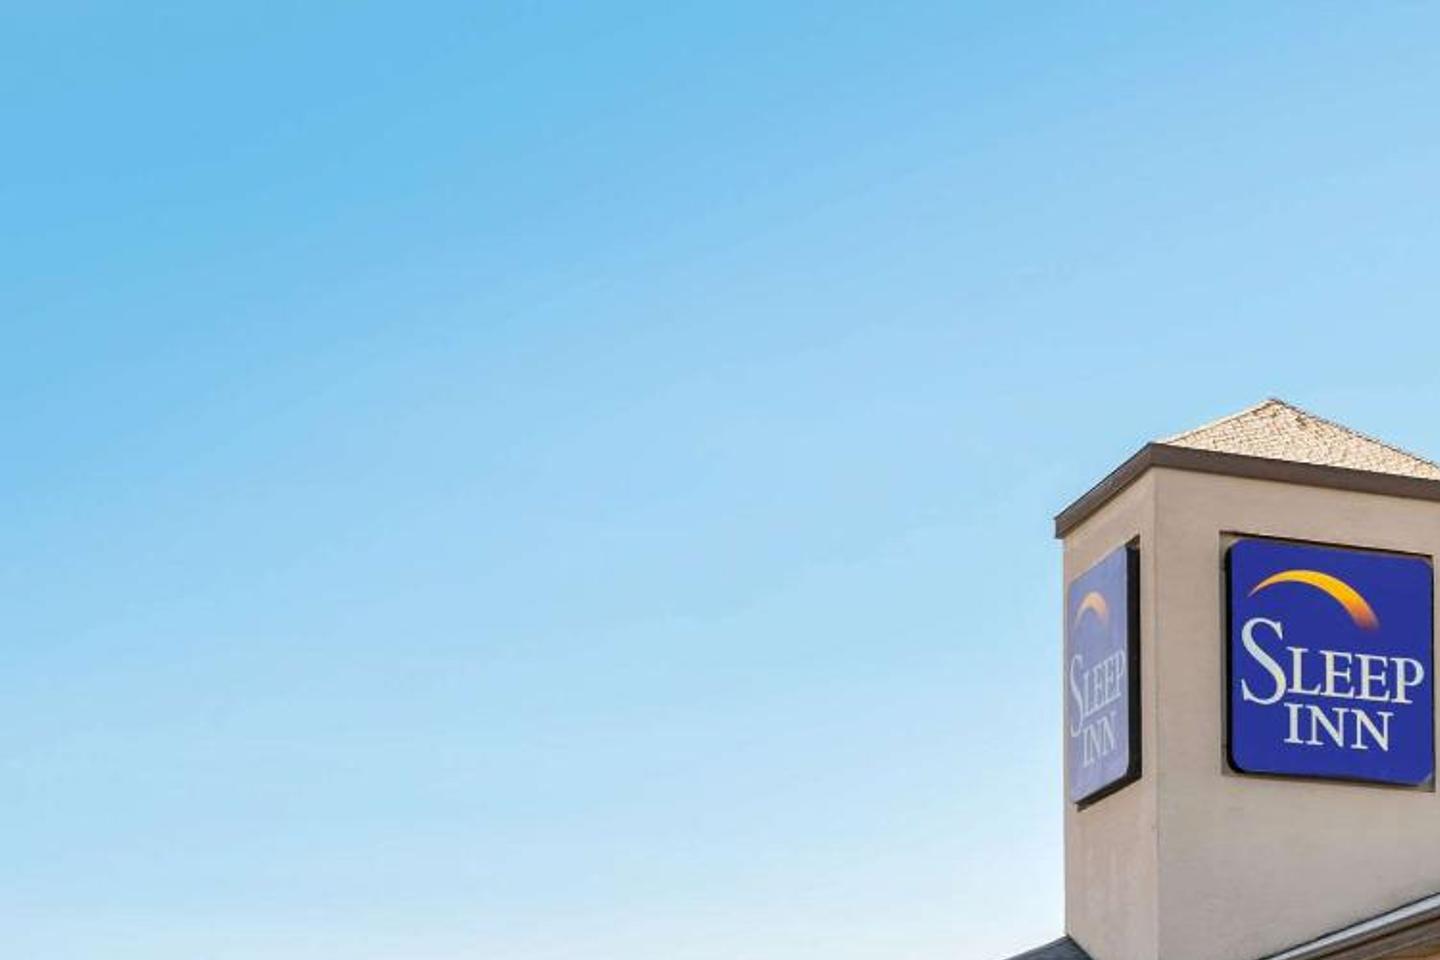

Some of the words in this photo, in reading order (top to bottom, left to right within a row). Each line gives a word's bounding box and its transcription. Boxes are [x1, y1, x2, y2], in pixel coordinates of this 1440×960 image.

[1070, 650, 1126, 738] SLEEP
[1241, 617, 1425, 705] SLEEP
[1083, 711, 1117, 768] INN
[1284, 702, 1394, 751] INN
